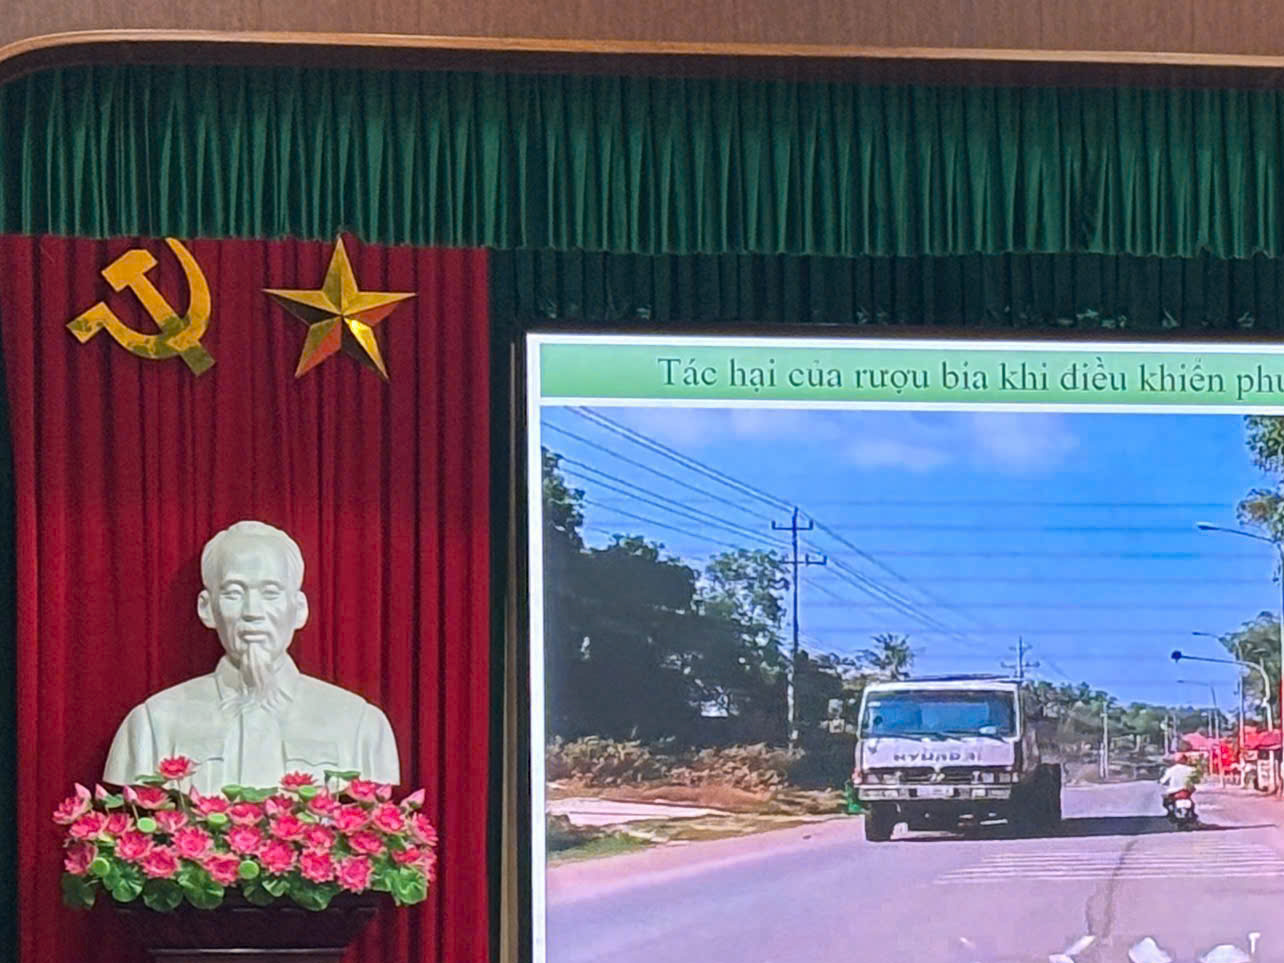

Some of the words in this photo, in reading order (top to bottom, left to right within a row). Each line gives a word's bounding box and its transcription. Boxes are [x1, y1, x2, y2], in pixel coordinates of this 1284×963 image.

[658, 358, 718, 387] Tác
[729, 358, 775, 393] hại
[788, 359, 842, 388] của
[855, 367, 930, 394] rượu
[942, 361, 989, 390] bia
[1000, 362, 1049, 391] khi
[1060, 356, 1127, 391] điều
[1138, 354, 1226, 393] khiển
